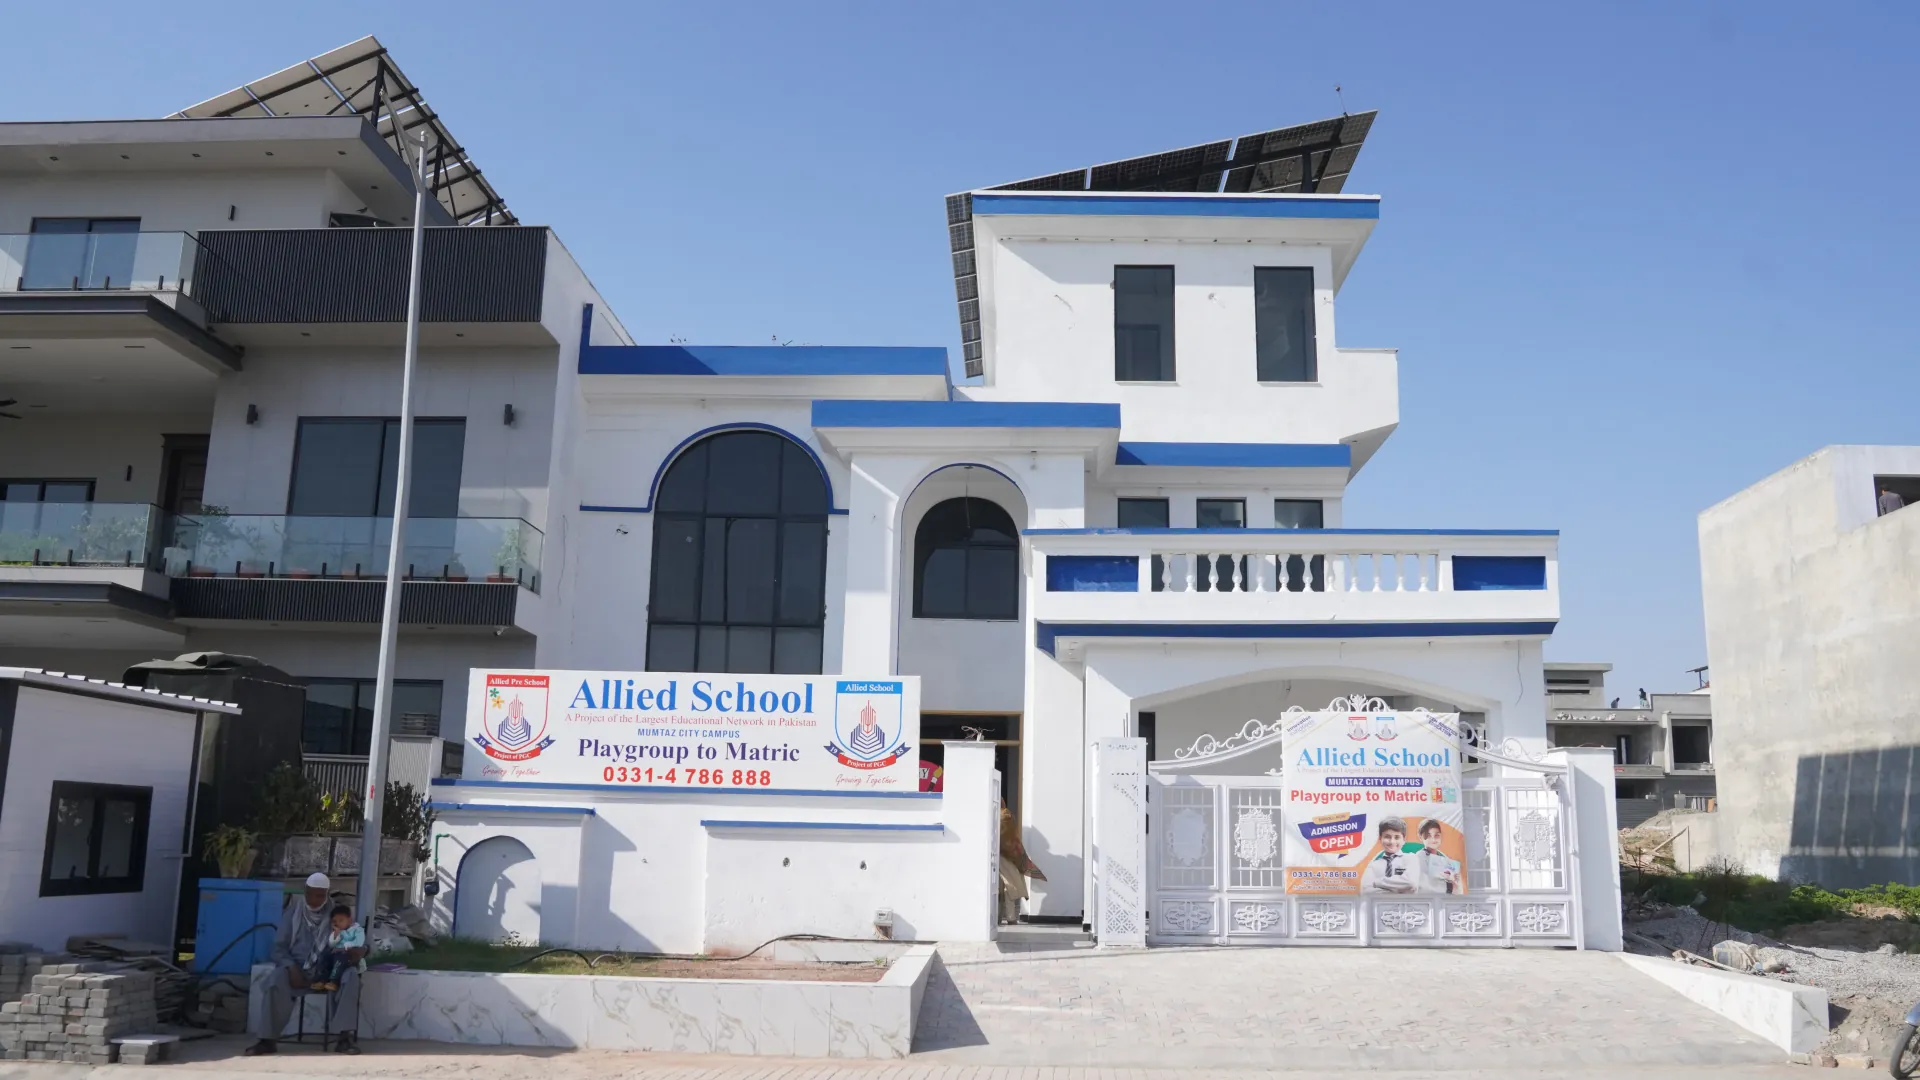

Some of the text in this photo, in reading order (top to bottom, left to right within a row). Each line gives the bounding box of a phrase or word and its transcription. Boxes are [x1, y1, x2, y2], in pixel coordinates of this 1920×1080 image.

[568, 678, 814, 713] Allied School
[564, 714, 817, 727] A Project of the Largest Educational Network in Pakistan
[638, 728, 740, 738] MUMTAZ CITY CAMPUS
[540, 740, 549, 748] 85
[494, 751, 511, 760] Project
[578, 738, 800, 764] Playgroup to Matric
[896, 748, 904, 756] 85
[1297, 747, 1450, 767] Allied School
[482, 764, 541, 777] Growing Together
[847, 760, 866, 768] Project
[603, 766, 771, 786] 0331-4 786 888
[835, 774, 897, 786] Growing Together
[1291, 790, 1361, 804] Playgroup
[1366, 790, 1379, 801] to
[1384, 790, 1427, 801] Matric
[1311, 822, 1358, 836] ADMISSION
[1320, 835, 1354, 850] OPEN
